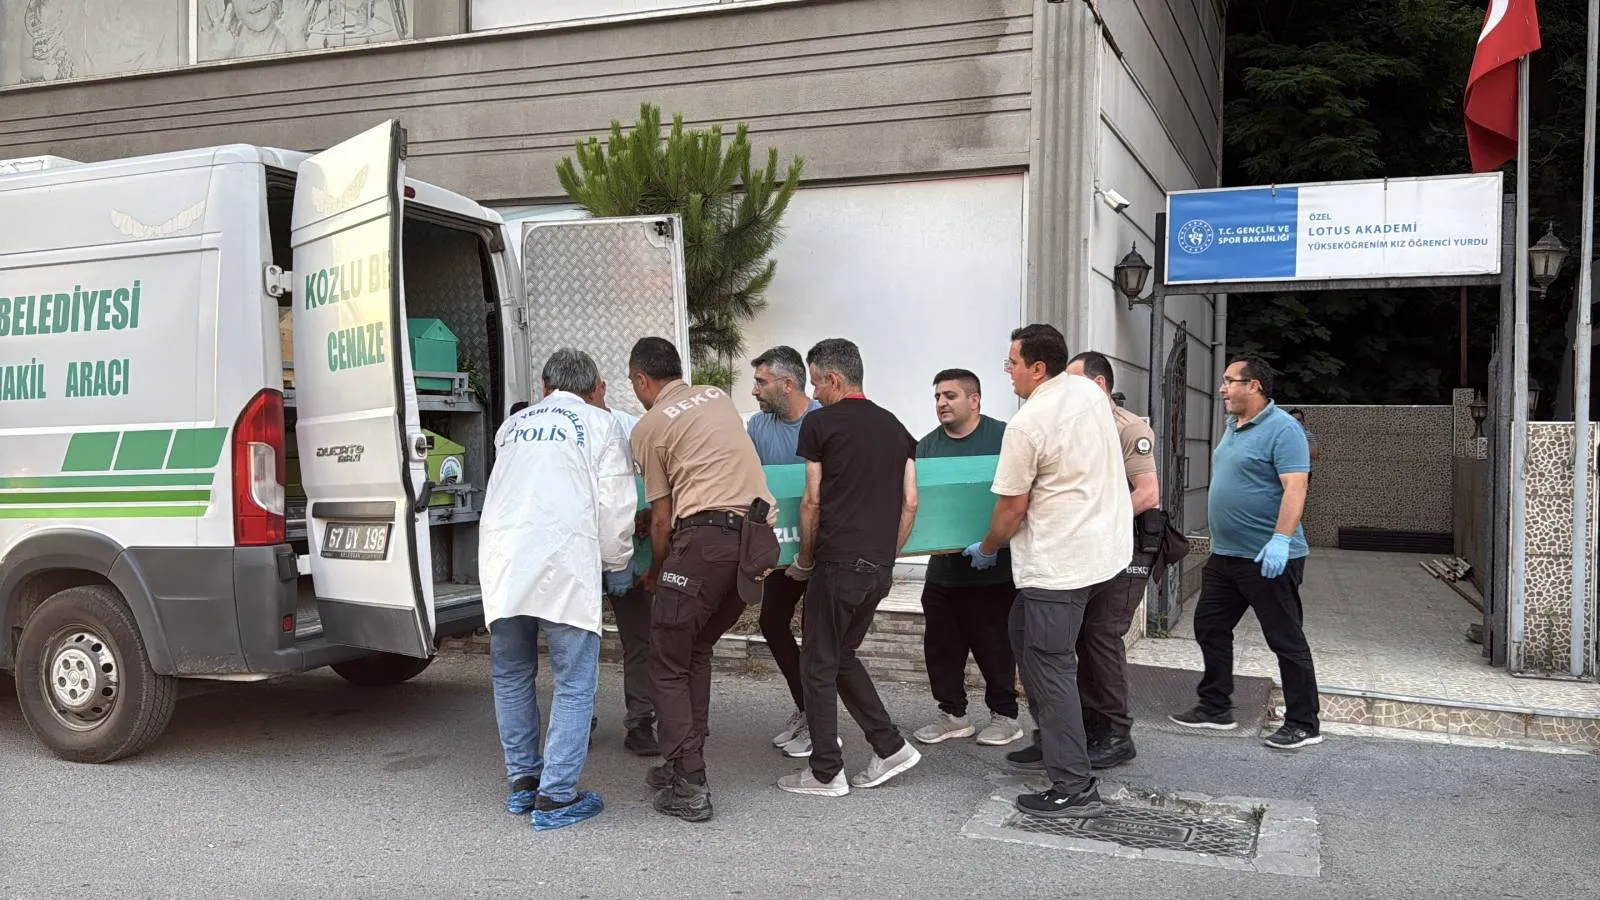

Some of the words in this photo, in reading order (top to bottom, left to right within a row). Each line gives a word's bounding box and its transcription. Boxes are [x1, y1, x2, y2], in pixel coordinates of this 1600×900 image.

[1309, 212, 1332, 221] ÖZEL
[1218, 227, 1235, 236] T.C.
[1236, 224, 1275, 237] GENÇLİK
[1278, 225, 1290, 233] VE
[1308, 225, 1351, 236] LOTUS
[1355, 221, 1417, 235] AKADEMİ
[1218, 236, 1241, 245] SPOR
[1242, 233, 1290, 244] BAKANLIĞI
[1308, 239, 1388, 251] YÜKSEKÖĞRENİM
[1390, 240, 1406, 248] KIZ
[1408, 236, 1451, 248] ÖĞRENCİ
[1454, 238, 1489, 246] YURDU
[305, 258, 363, 311] KOZLU
[0, 279, 141, 337] BELEDİYESİ
[327, 321, 385, 373] CENAZE
[65, 358, 130, 398] ARACI
[513, 425, 568, 443] POLİS
[328, 527, 343, 549] 67
[345, 527, 361, 550] DY
[363, 527, 386, 551] 196
[773, 525, 801, 543] ZLU
